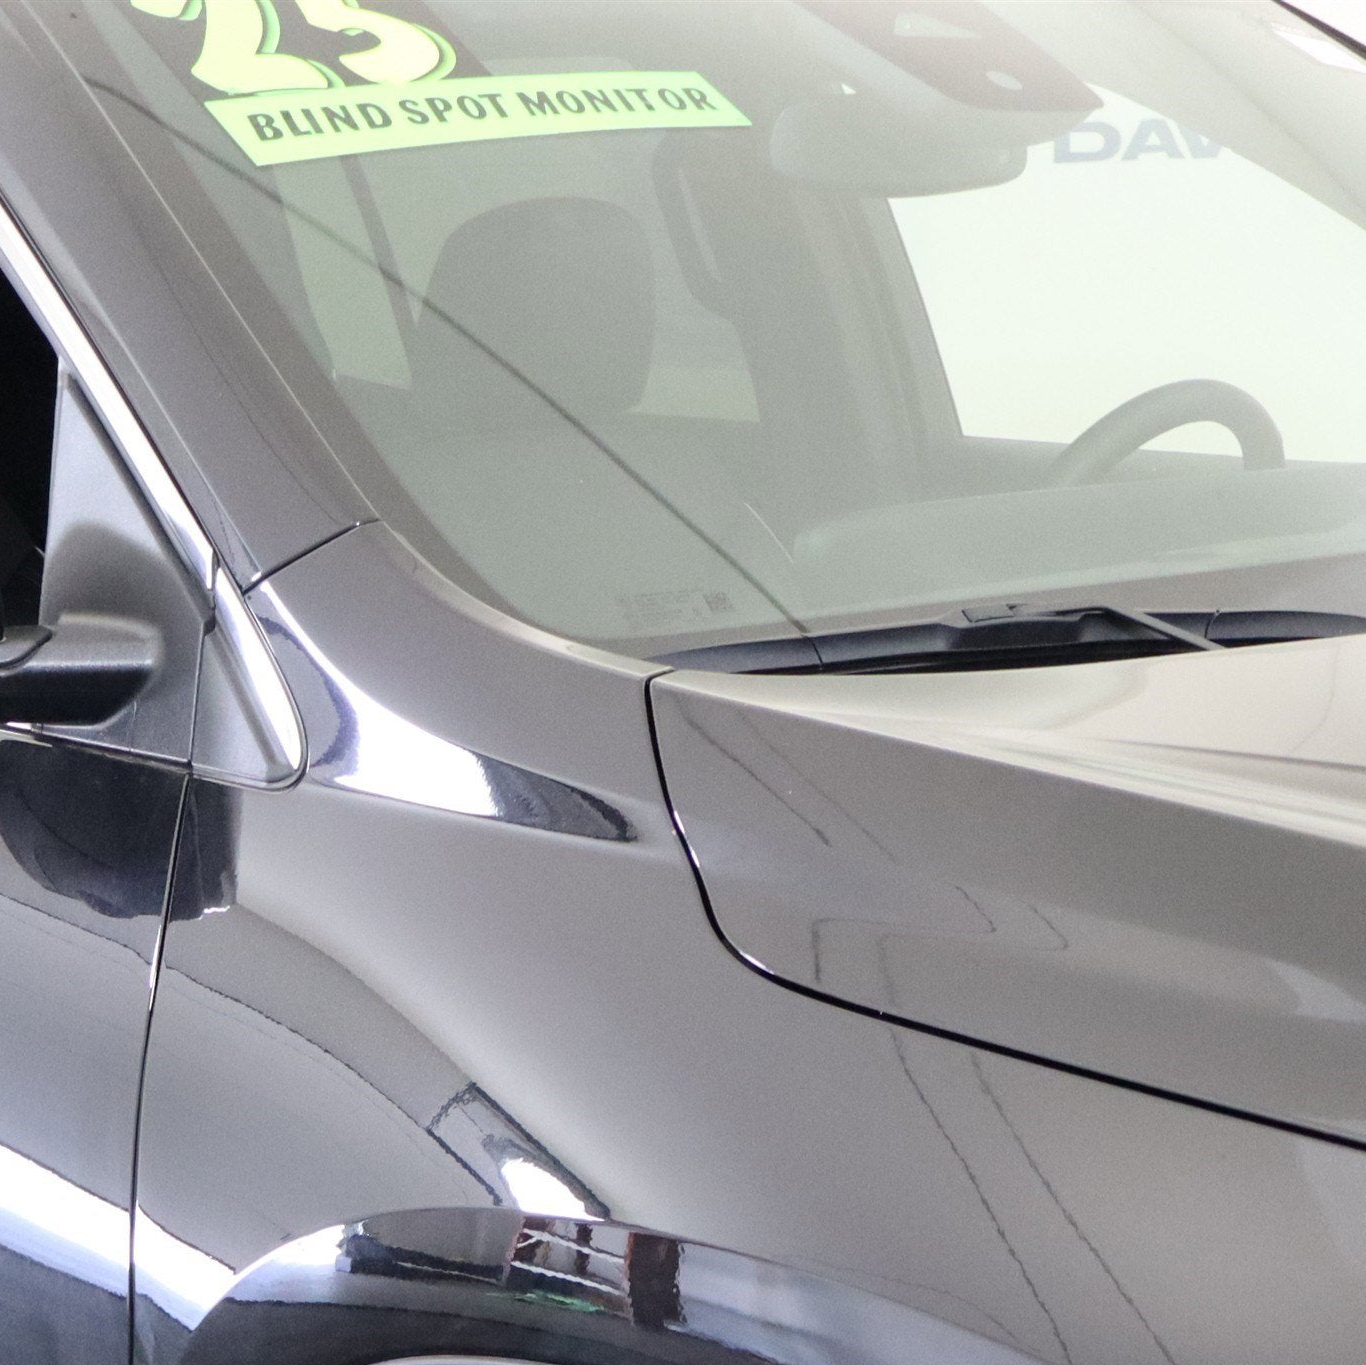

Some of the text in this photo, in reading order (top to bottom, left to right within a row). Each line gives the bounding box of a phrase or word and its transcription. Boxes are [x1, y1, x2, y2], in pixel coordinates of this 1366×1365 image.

[247, 87, 718, 141] BLIND SPOT MONITOR
